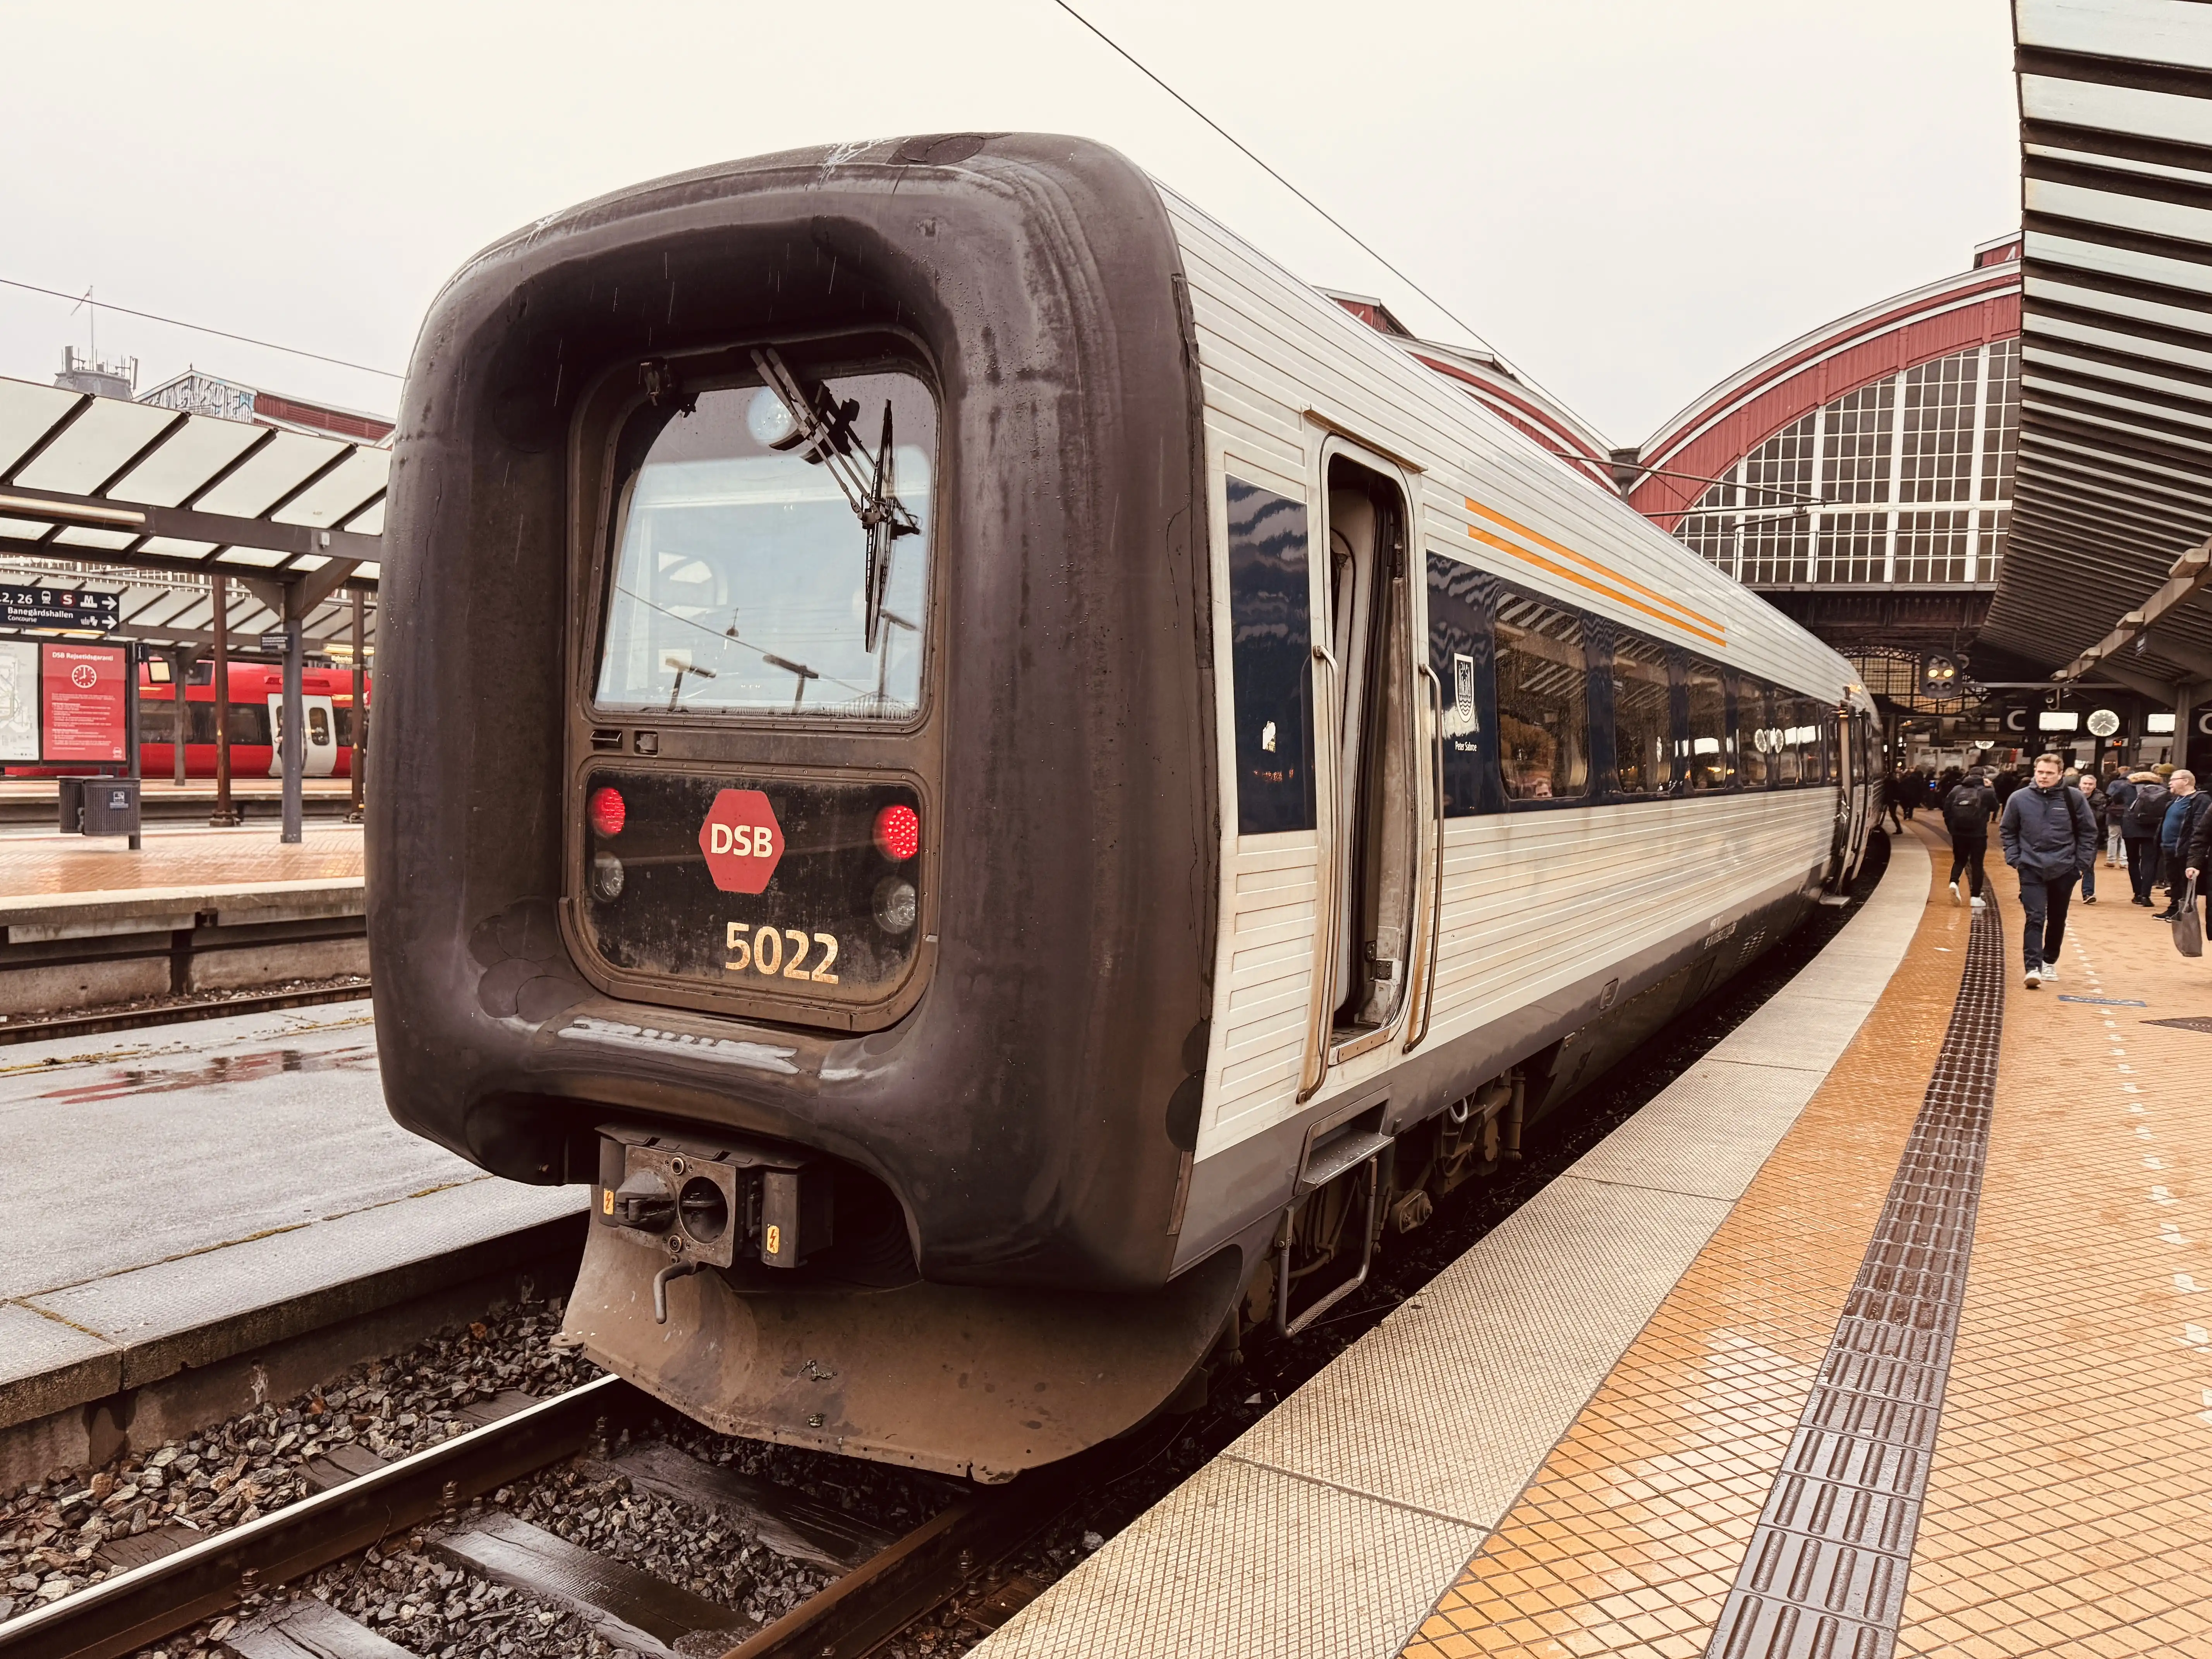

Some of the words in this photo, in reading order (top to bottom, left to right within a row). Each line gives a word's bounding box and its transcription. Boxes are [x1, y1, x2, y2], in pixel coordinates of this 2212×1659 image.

[0, 592, 14, 605] 2,
[17, 593, 33, 605] 26
[63, 594, 72, 605] S
[8, 606, 73, 619] Banegårdshallen
[8, 615, 37, 623] Concourse
[2007, 709, 2026, 731] C
[1455, 741, 1465, 750] Peter
[711, 823, 773, 857] DSB
[725, 921, 839, 984] 5022
